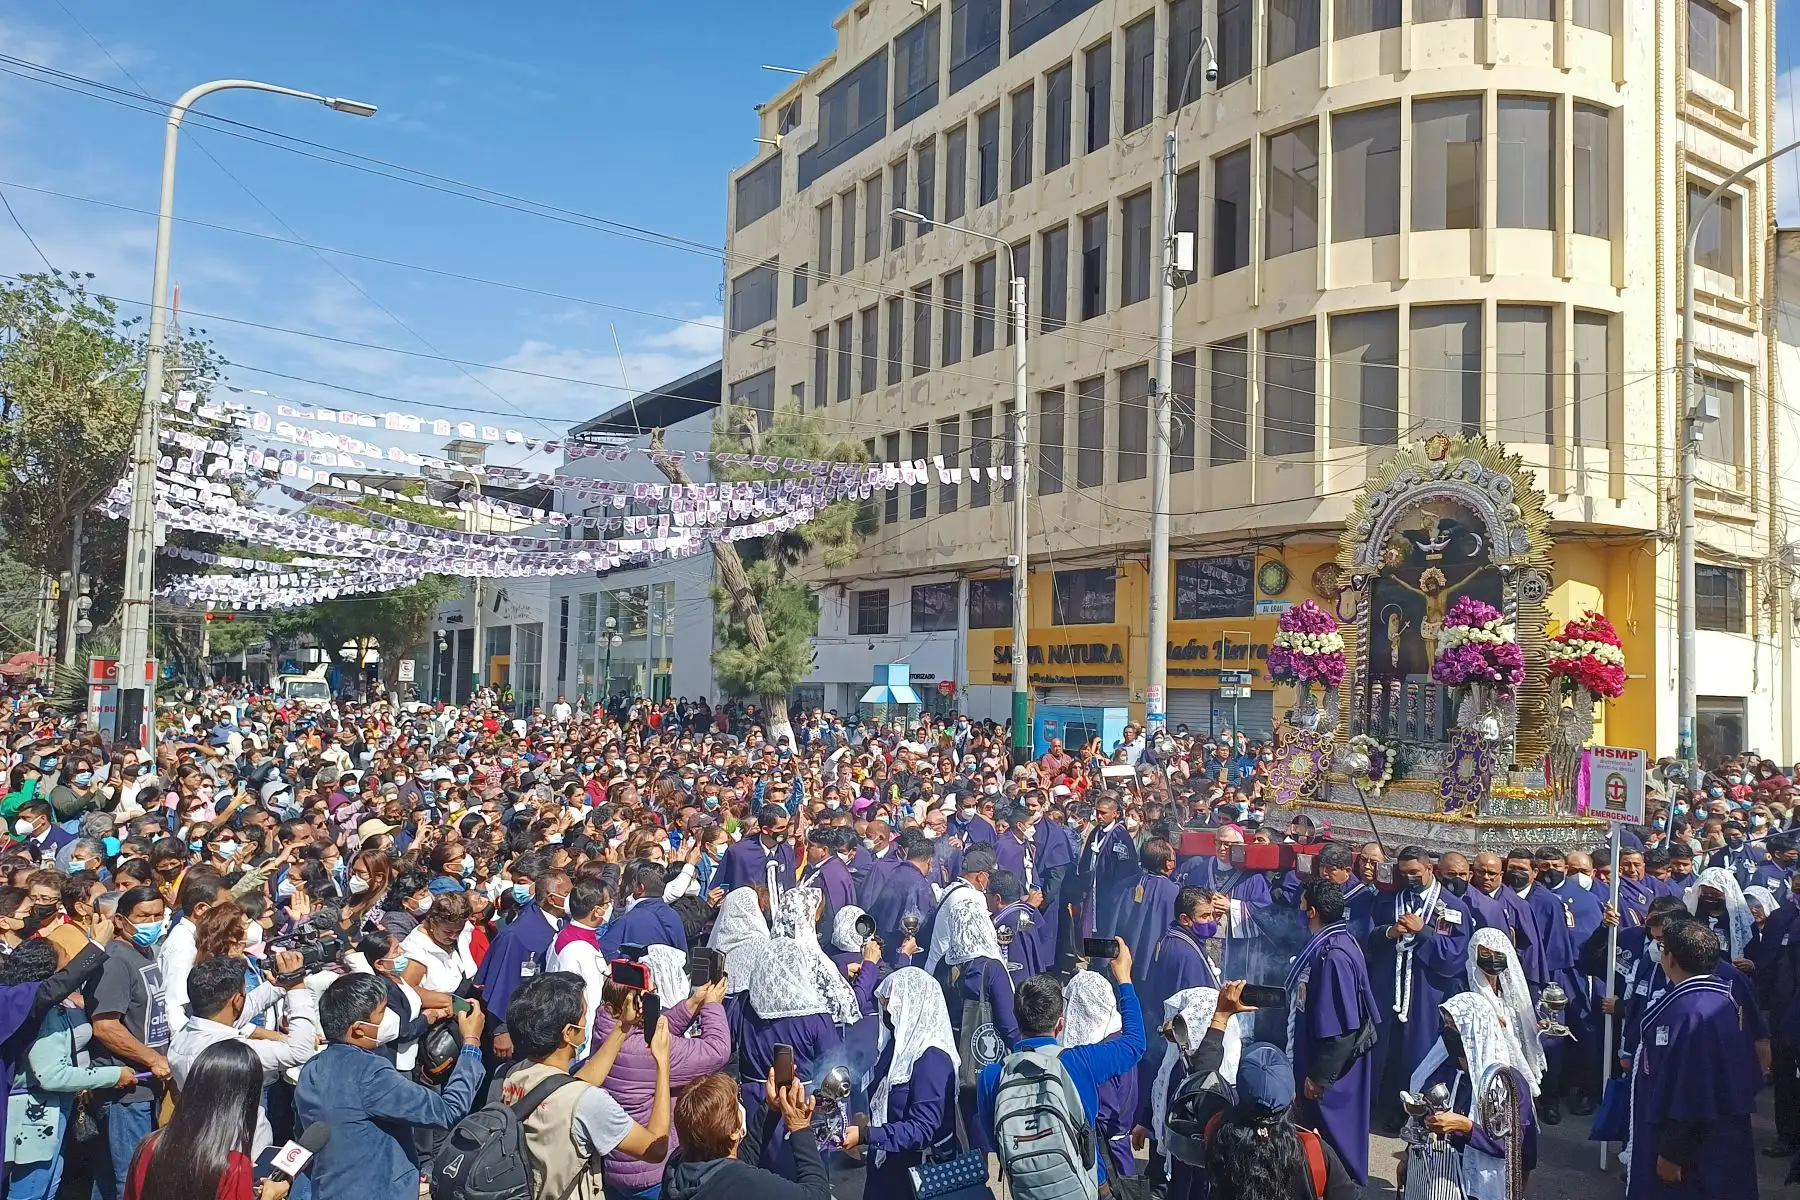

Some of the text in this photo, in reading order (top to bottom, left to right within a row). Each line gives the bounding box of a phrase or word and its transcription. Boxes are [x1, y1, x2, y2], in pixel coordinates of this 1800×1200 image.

[993, 643, 1123, 664] SATA NATURA
[1594, 747, 1639, 760] HSMP
[1590, 809, 1639, 822] EMERGENCIA
